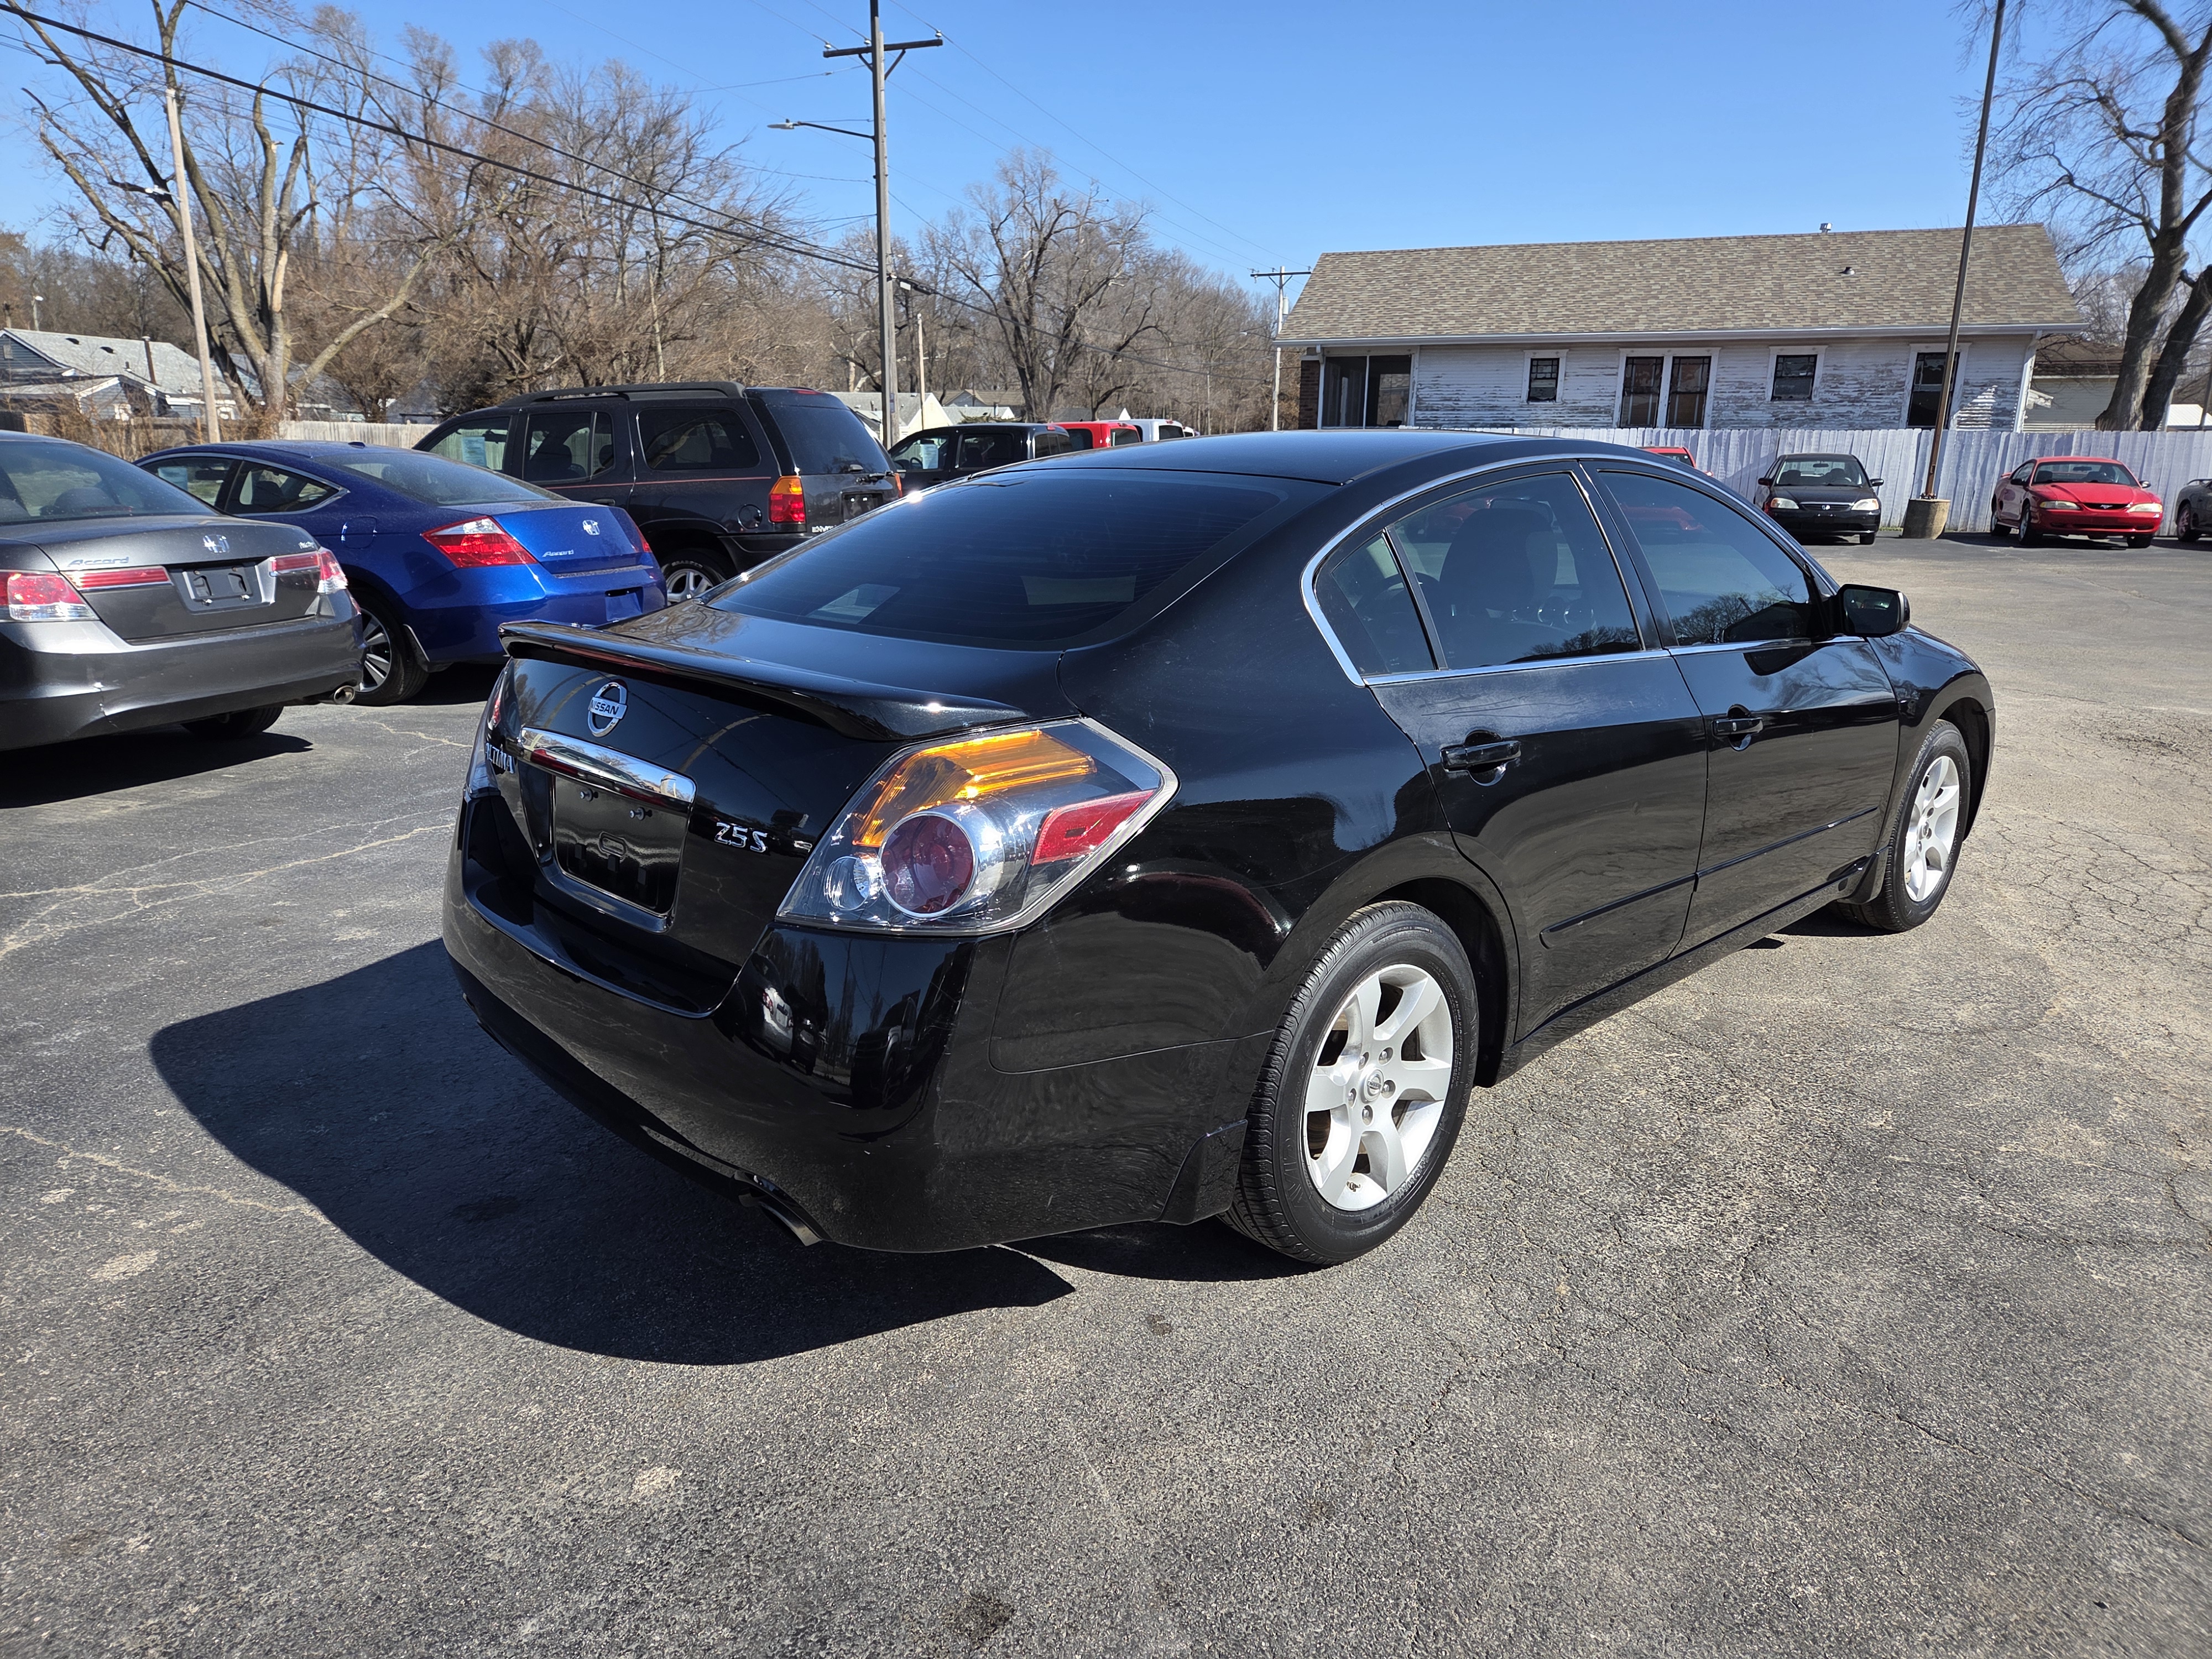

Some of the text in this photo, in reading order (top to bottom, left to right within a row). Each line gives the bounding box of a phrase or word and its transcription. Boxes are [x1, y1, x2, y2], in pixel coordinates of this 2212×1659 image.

[67, 556, 129, 567] Accord
[590, 699, 619, 715] NISSAN
[486, 742, 514, 774] ALTIMA
[1457, 1012, 1478, 1118] YOKOHAMA
